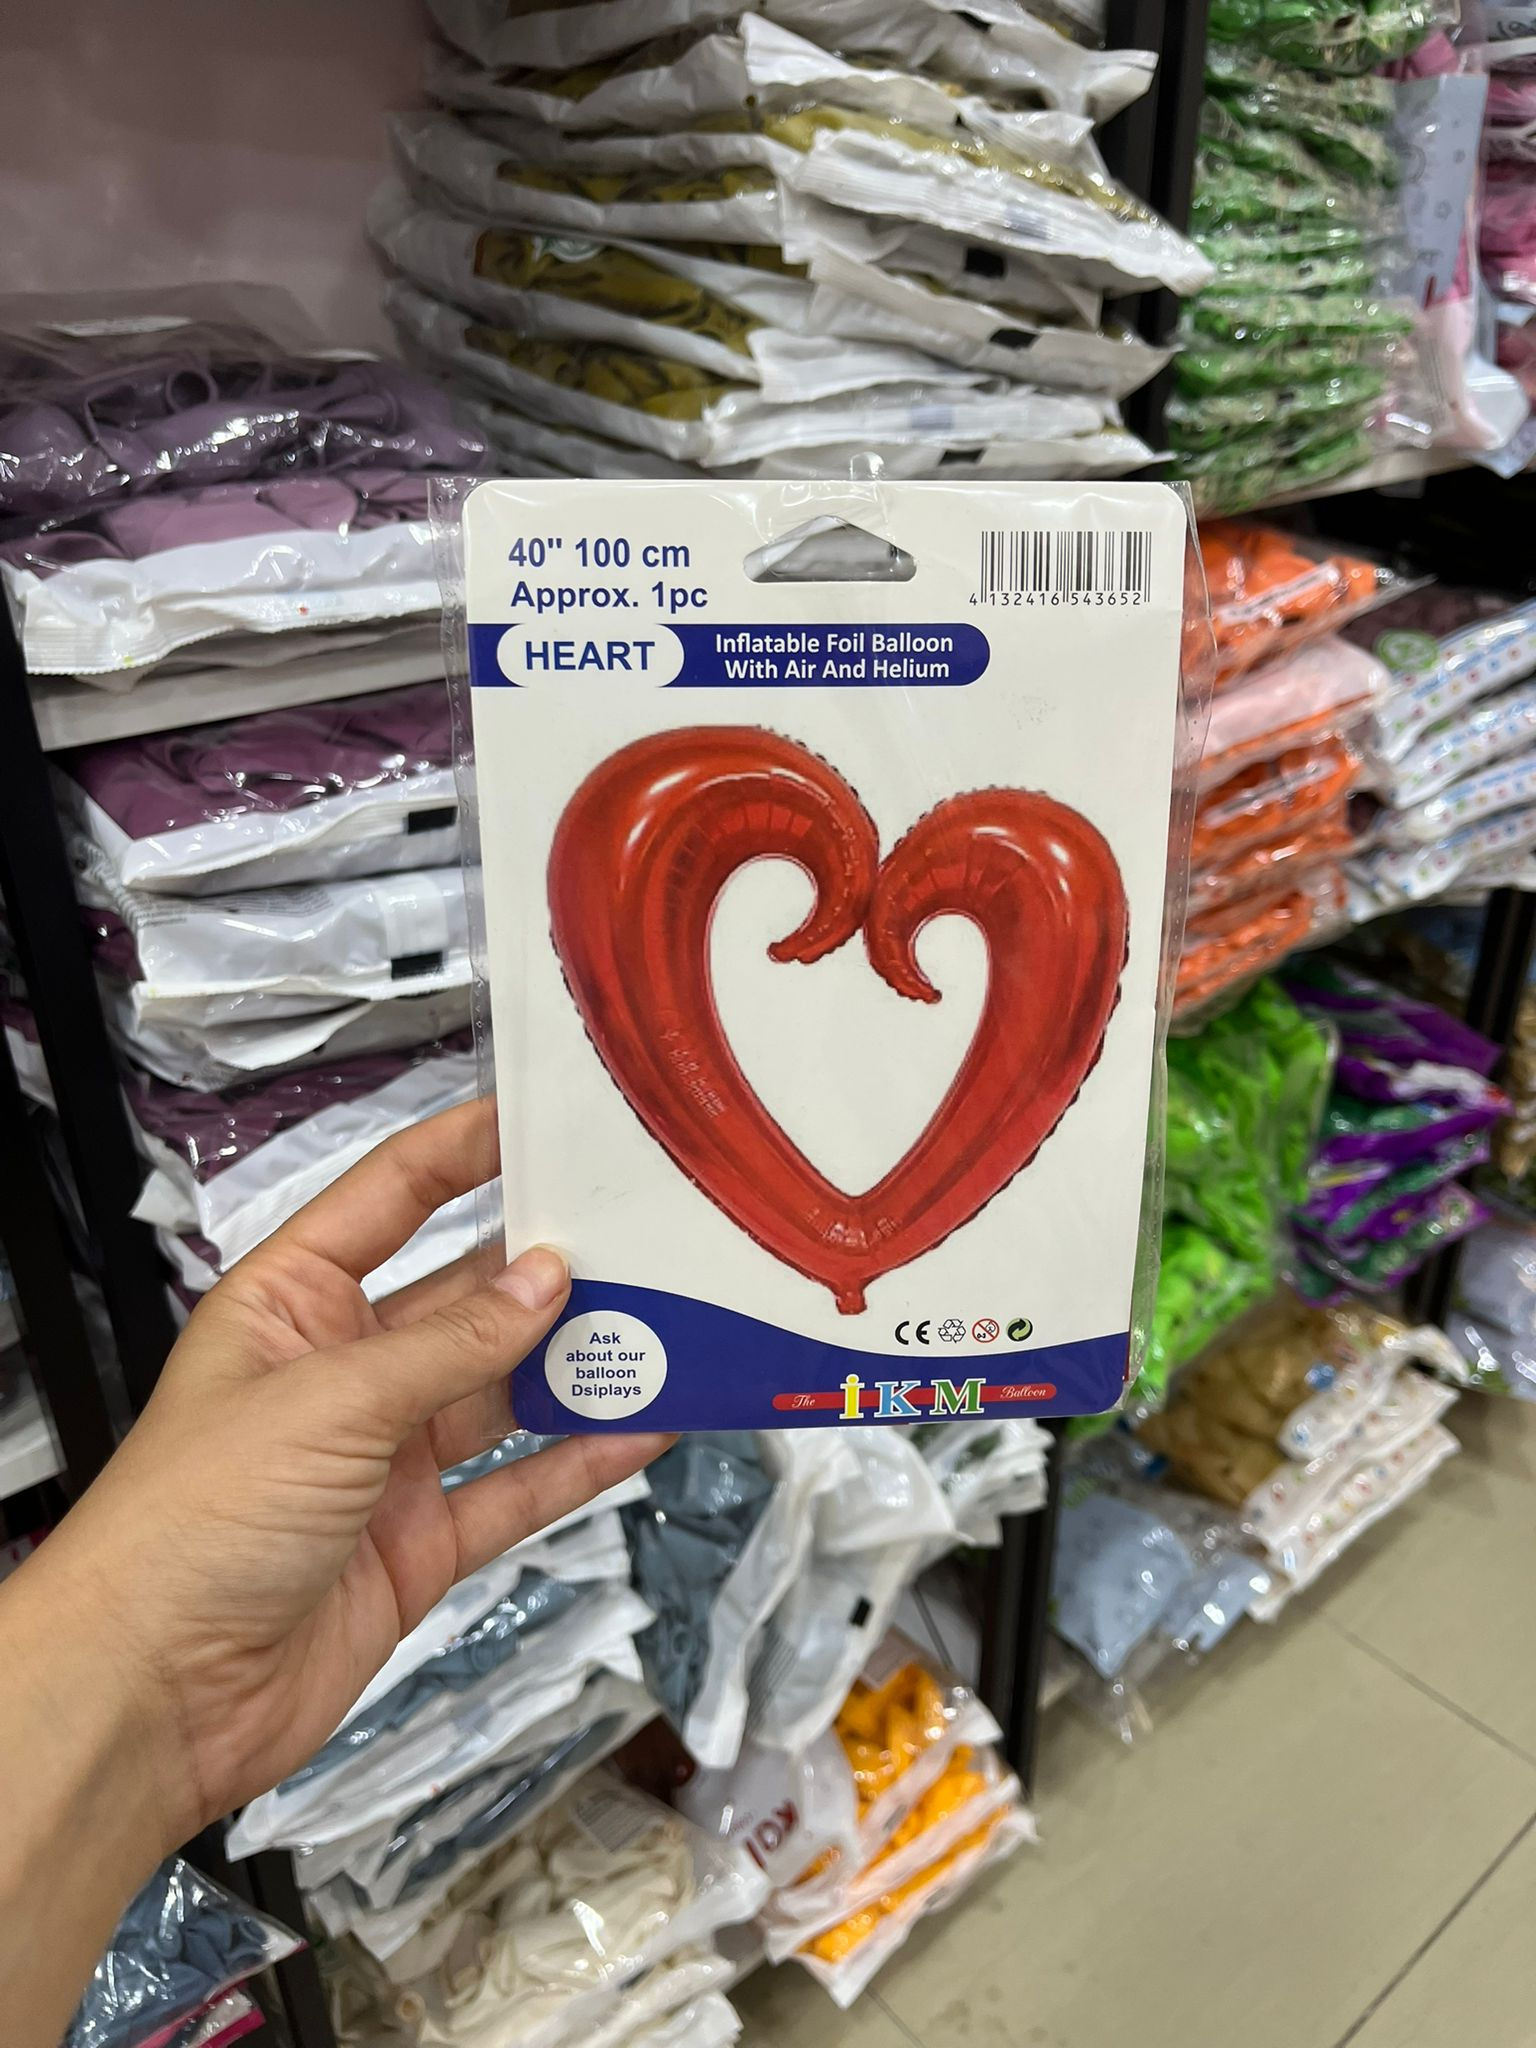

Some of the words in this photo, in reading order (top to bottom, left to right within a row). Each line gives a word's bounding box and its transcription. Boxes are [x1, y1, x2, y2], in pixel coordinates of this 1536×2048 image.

[574, 538, 631, 567] 100
[642, 542, 690, 567] cm
[510, 582, 638, 613] Approx.
[651, 582, 708, 613] 1pc
[969, 592, 1141, 605] 4132416543652
[716, 633, 819, 653] Inflatable
[828, 633, 864, 652] Foil
[871, 633, 954, 651] Balloon
[524, 641, 655, 671] HEART
[725, 659, 777, 679] With
[783, 659, 816, 679] Air
[822, 658, 865, 678] And
[873, 658, 950, 679] Helium
[589, 1332, 621, 1344] Ask
[895, 1320, 931, 1345] CE
[566, 1350, 613, 1362] about
[618, 1352, 646, 1361] our
[576, 1367, 636, 1379] balloon
[572, 1384, 641, 1398] Dsiplays
[791, 1395, 816, 1408] The
[1000, 1384, 1047, 1399] Balloon
